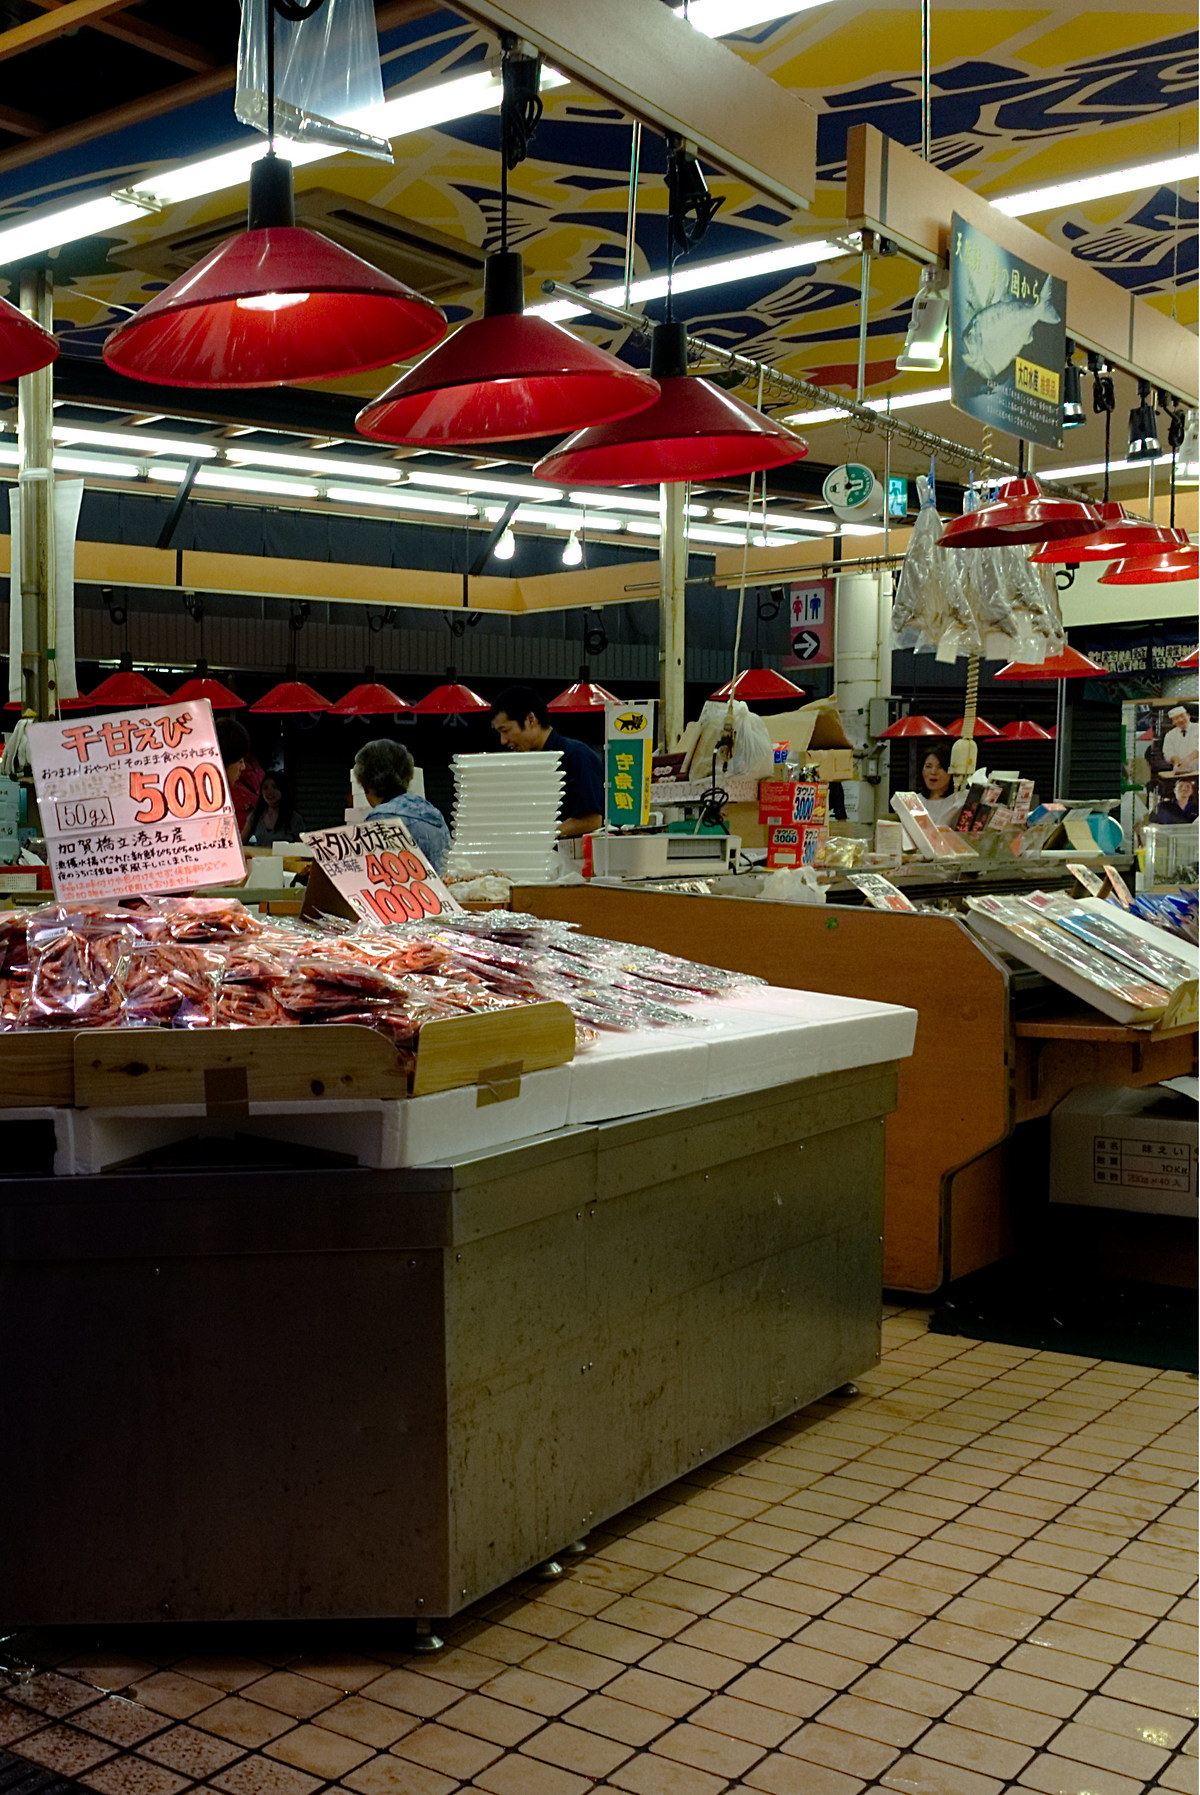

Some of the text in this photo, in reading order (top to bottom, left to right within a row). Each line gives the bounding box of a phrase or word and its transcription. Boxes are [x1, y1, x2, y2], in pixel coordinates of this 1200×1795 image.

[61, 712, 193, 763] 干甘えび
[124, 748, 219, 767] そのまま食べられます。
[613, 752, 634, 810] 宅急便
[795, 785, 816, 797] タウリン
[793, 796, 815, 821] 3000
[58, 827, 186, 855] 加賀橋立港名産
[774, 834, 798, 843] 3000
